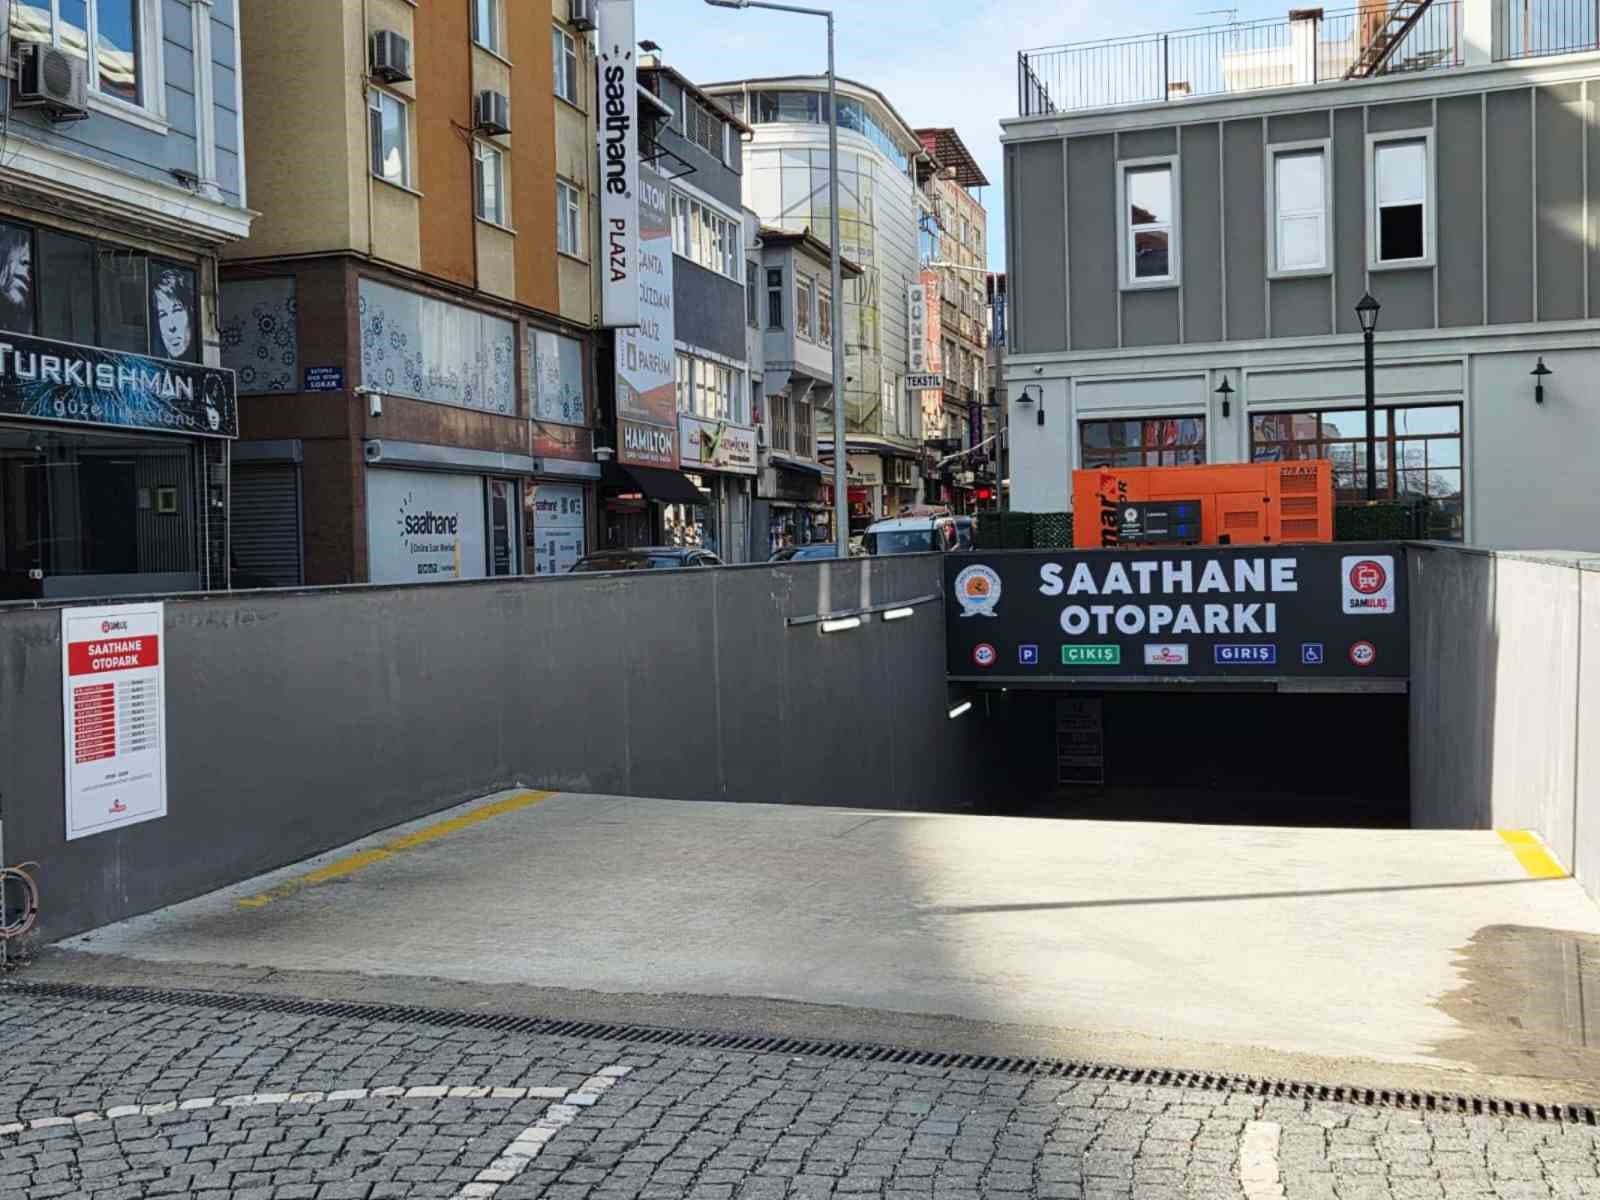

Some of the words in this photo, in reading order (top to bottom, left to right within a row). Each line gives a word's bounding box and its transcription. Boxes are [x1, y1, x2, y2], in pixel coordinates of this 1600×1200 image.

[605, 65, 629, 195] saathane
[639, 181, 667, 215] ILTON
[610, 217, 627, 284] PLAZA
[0, 342, 194, 401] TURKISHMAN
[638, 350, 671, 376] PARFÜM
[624, 426, 673, 457] HAMILTON
[405, 511, 457, 535] saathane
[1039, 557, 1298, 596] SAATHANE
[1059, 602, 1277, 635] OTOPARKI
[88, 640, 142, 656] SAATHANE
[92, 655, 138, 670] OTOPARK
[1068, 648, 1114, 661] ÇIKIŞ
